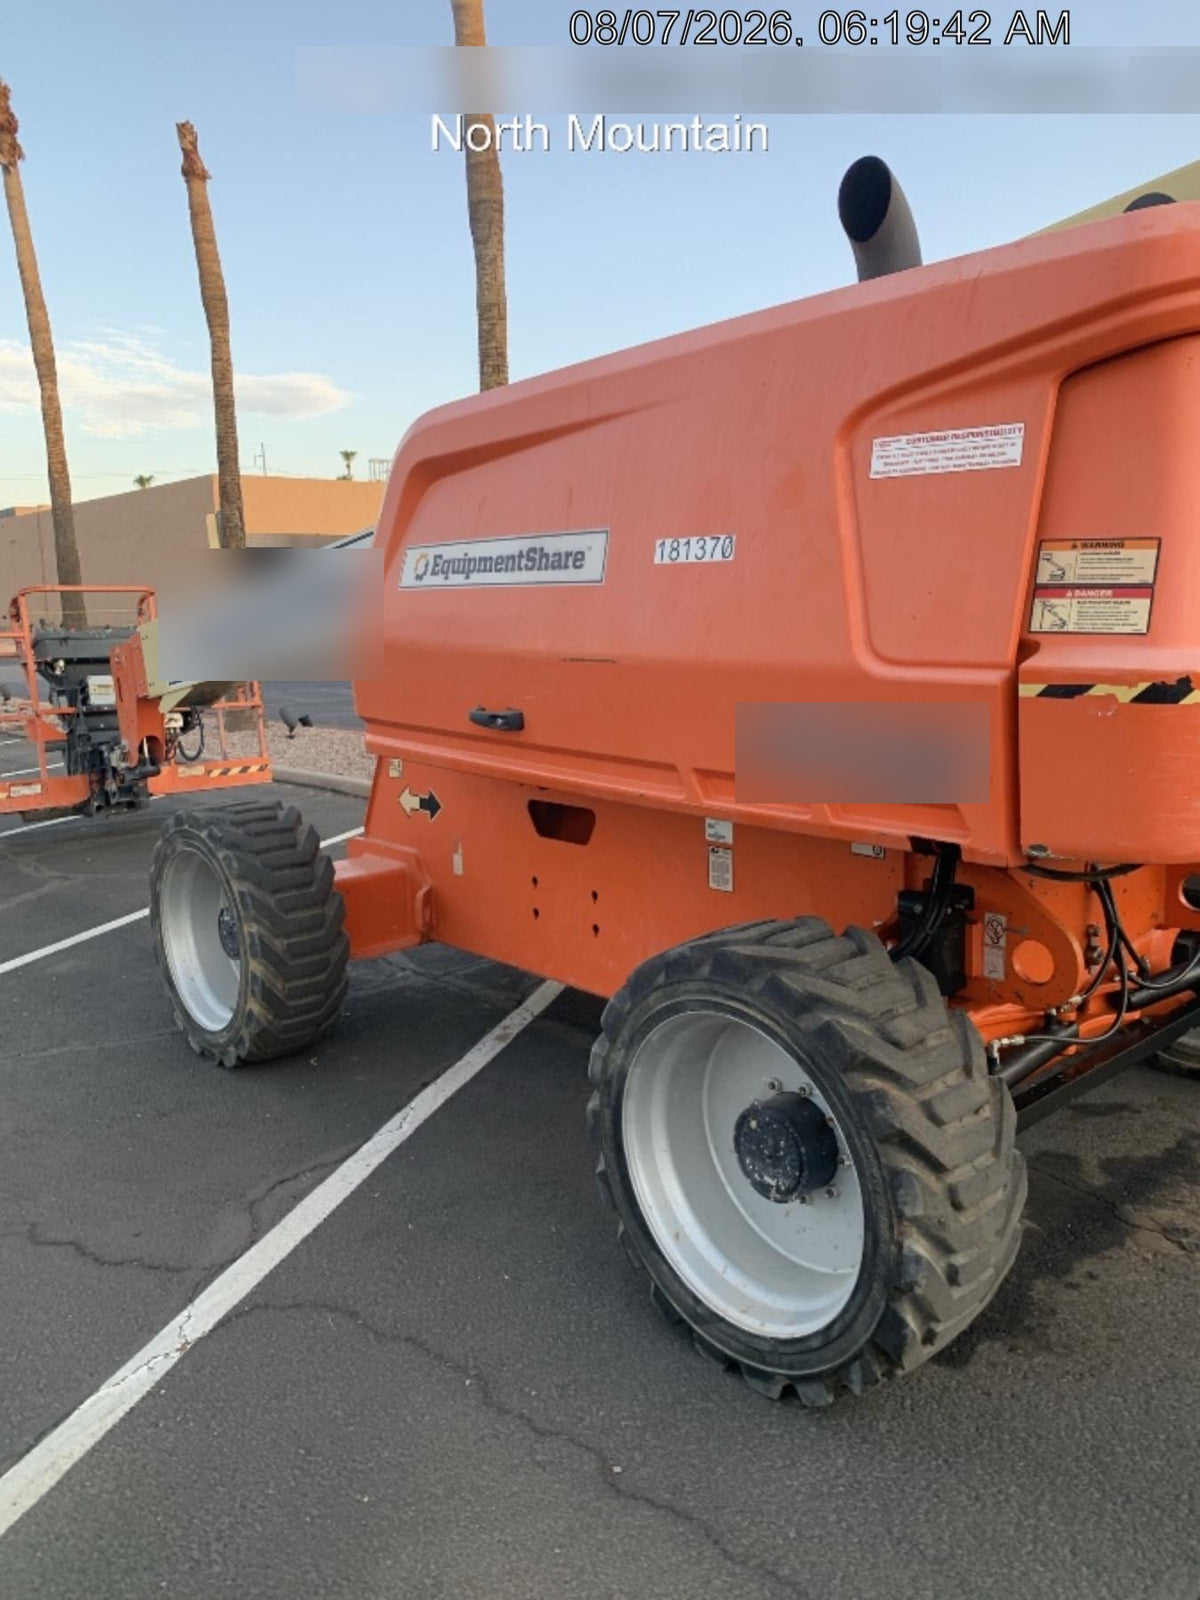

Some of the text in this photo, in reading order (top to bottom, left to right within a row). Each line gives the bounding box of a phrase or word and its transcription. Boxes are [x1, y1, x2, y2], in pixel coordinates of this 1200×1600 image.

[657, 536, 735, 562] 181370
[1080, 540, 1125, 549] WARNING
[430, 547, 586, 581] EquipmentShare
